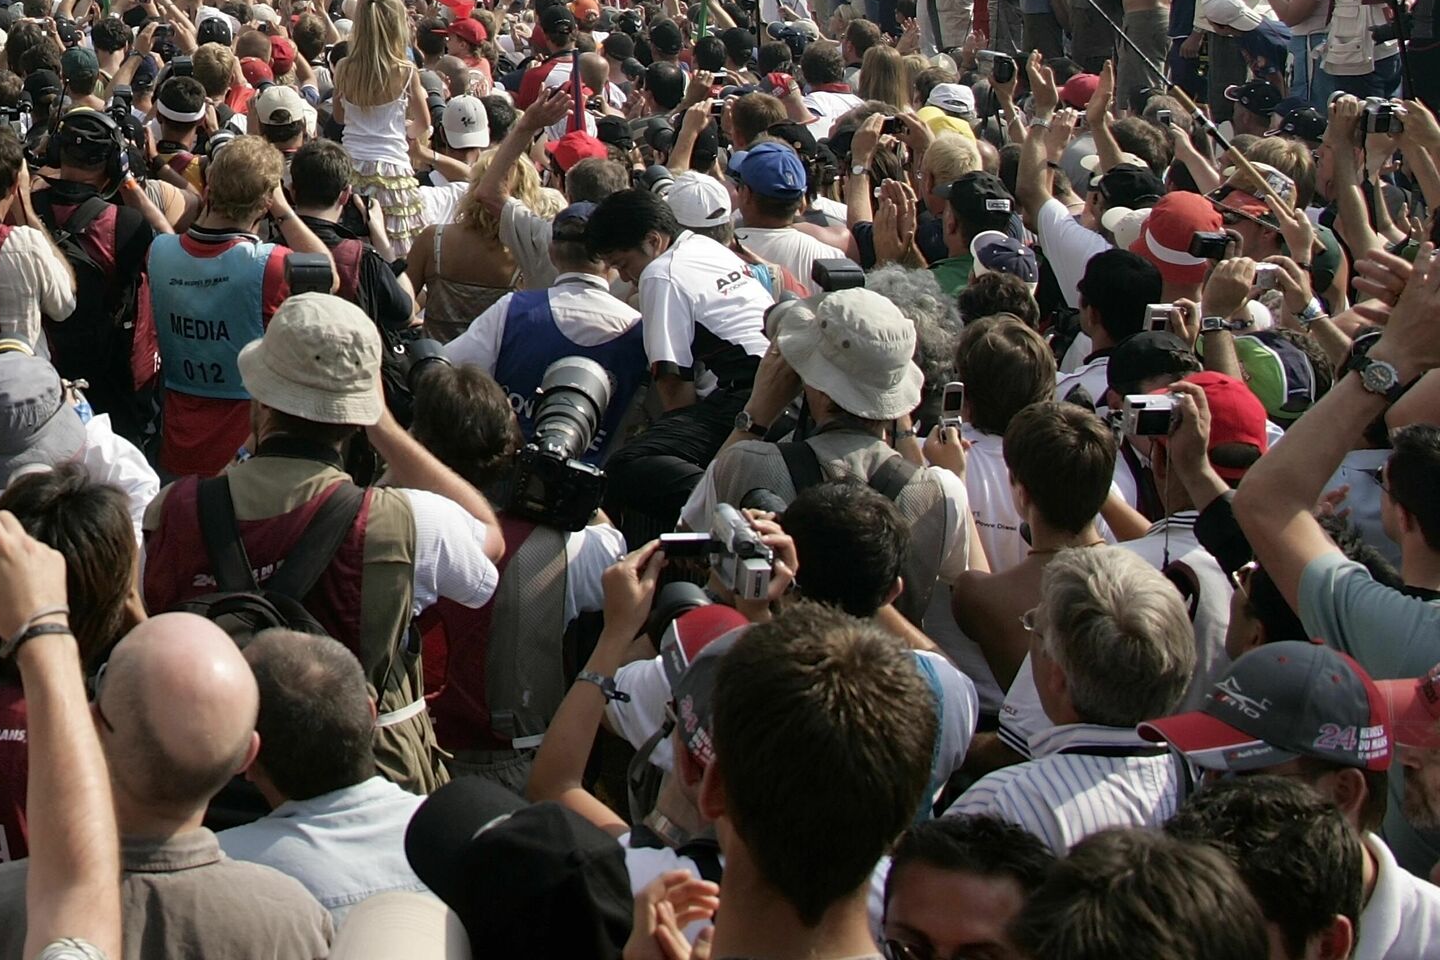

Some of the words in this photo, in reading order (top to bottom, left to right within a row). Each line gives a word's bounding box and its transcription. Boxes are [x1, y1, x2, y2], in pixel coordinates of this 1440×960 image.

[170, 313, 230, 341] MEDIA
[184, 359, 225, 384] 012
[1313, 722, 1357, 751] 24
